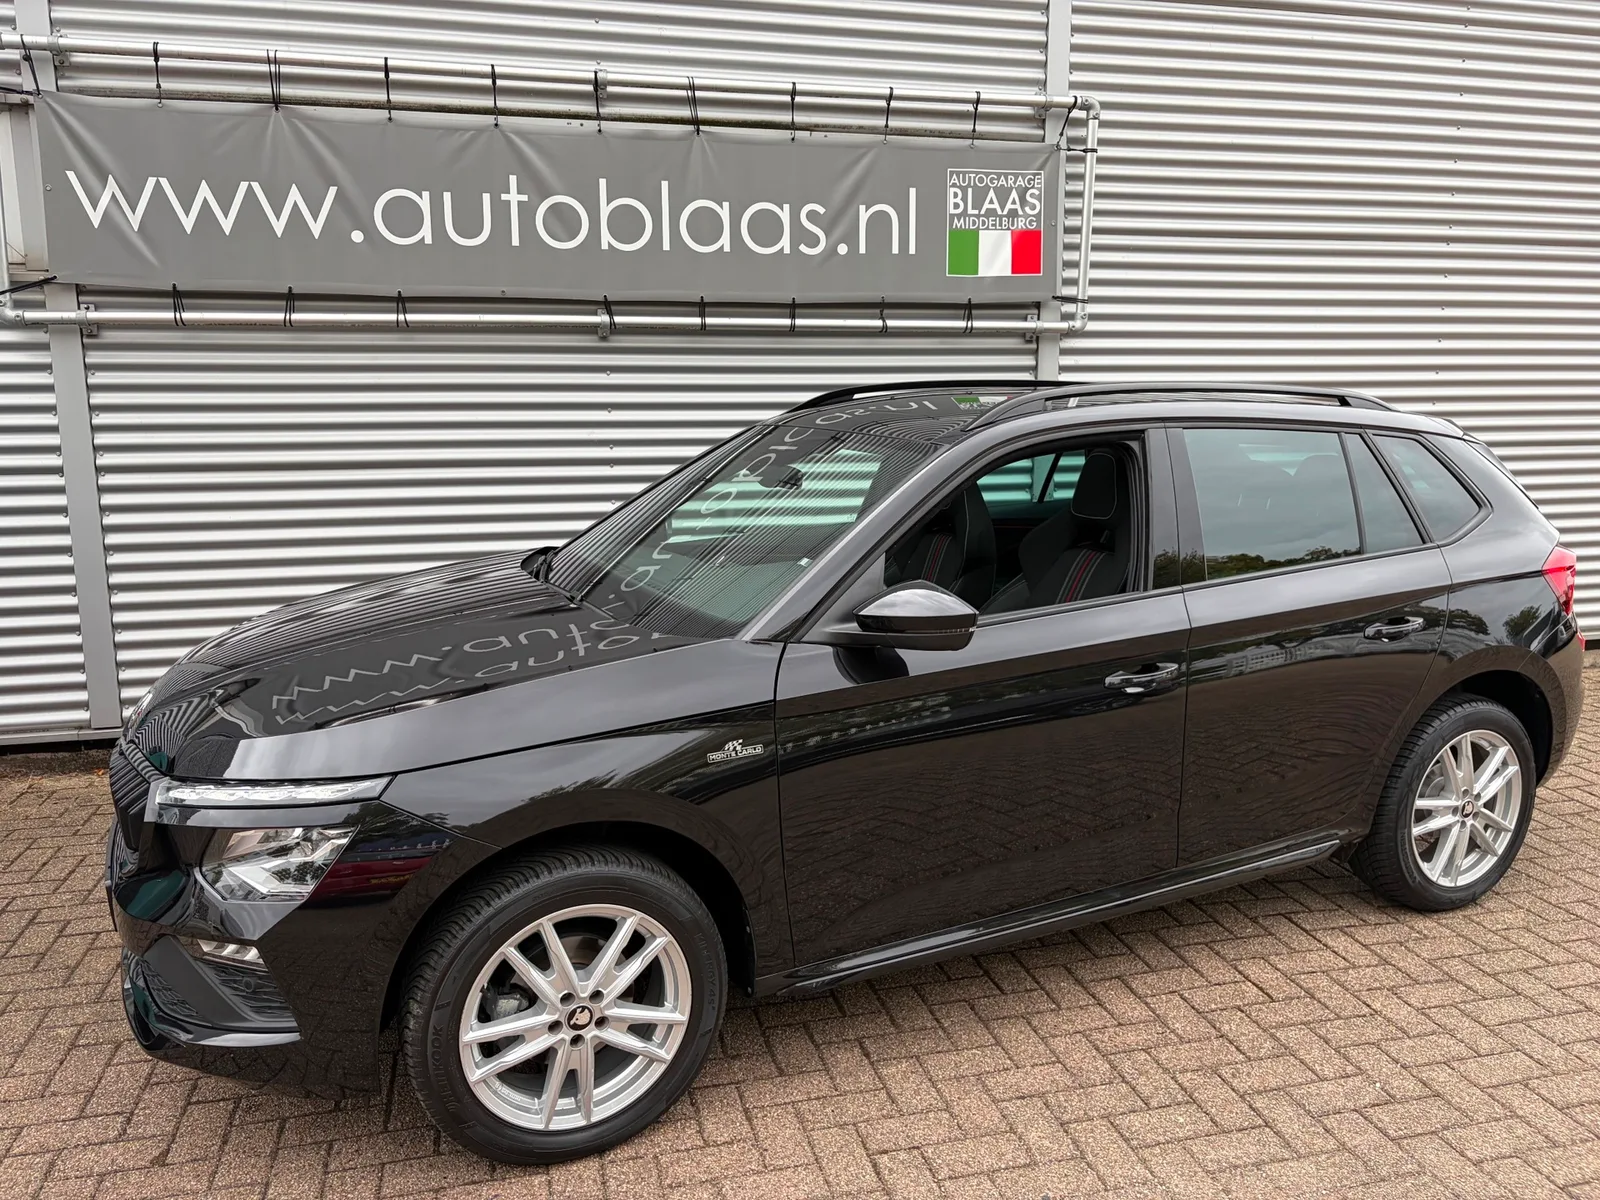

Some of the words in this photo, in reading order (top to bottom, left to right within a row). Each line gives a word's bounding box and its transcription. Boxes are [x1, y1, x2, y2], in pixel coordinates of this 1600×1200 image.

[949, 173, 1042, 188] AUTOGARAGE
[949, 187, 1041, 215] BLAAS
[65, 169, 917, 255] www.autoblaas.nl
[952, 216, 1037, 229] MIDDELBURG
[709, 751, 736, 761] MONTE
[737, 746, 762, 756] CARLO
